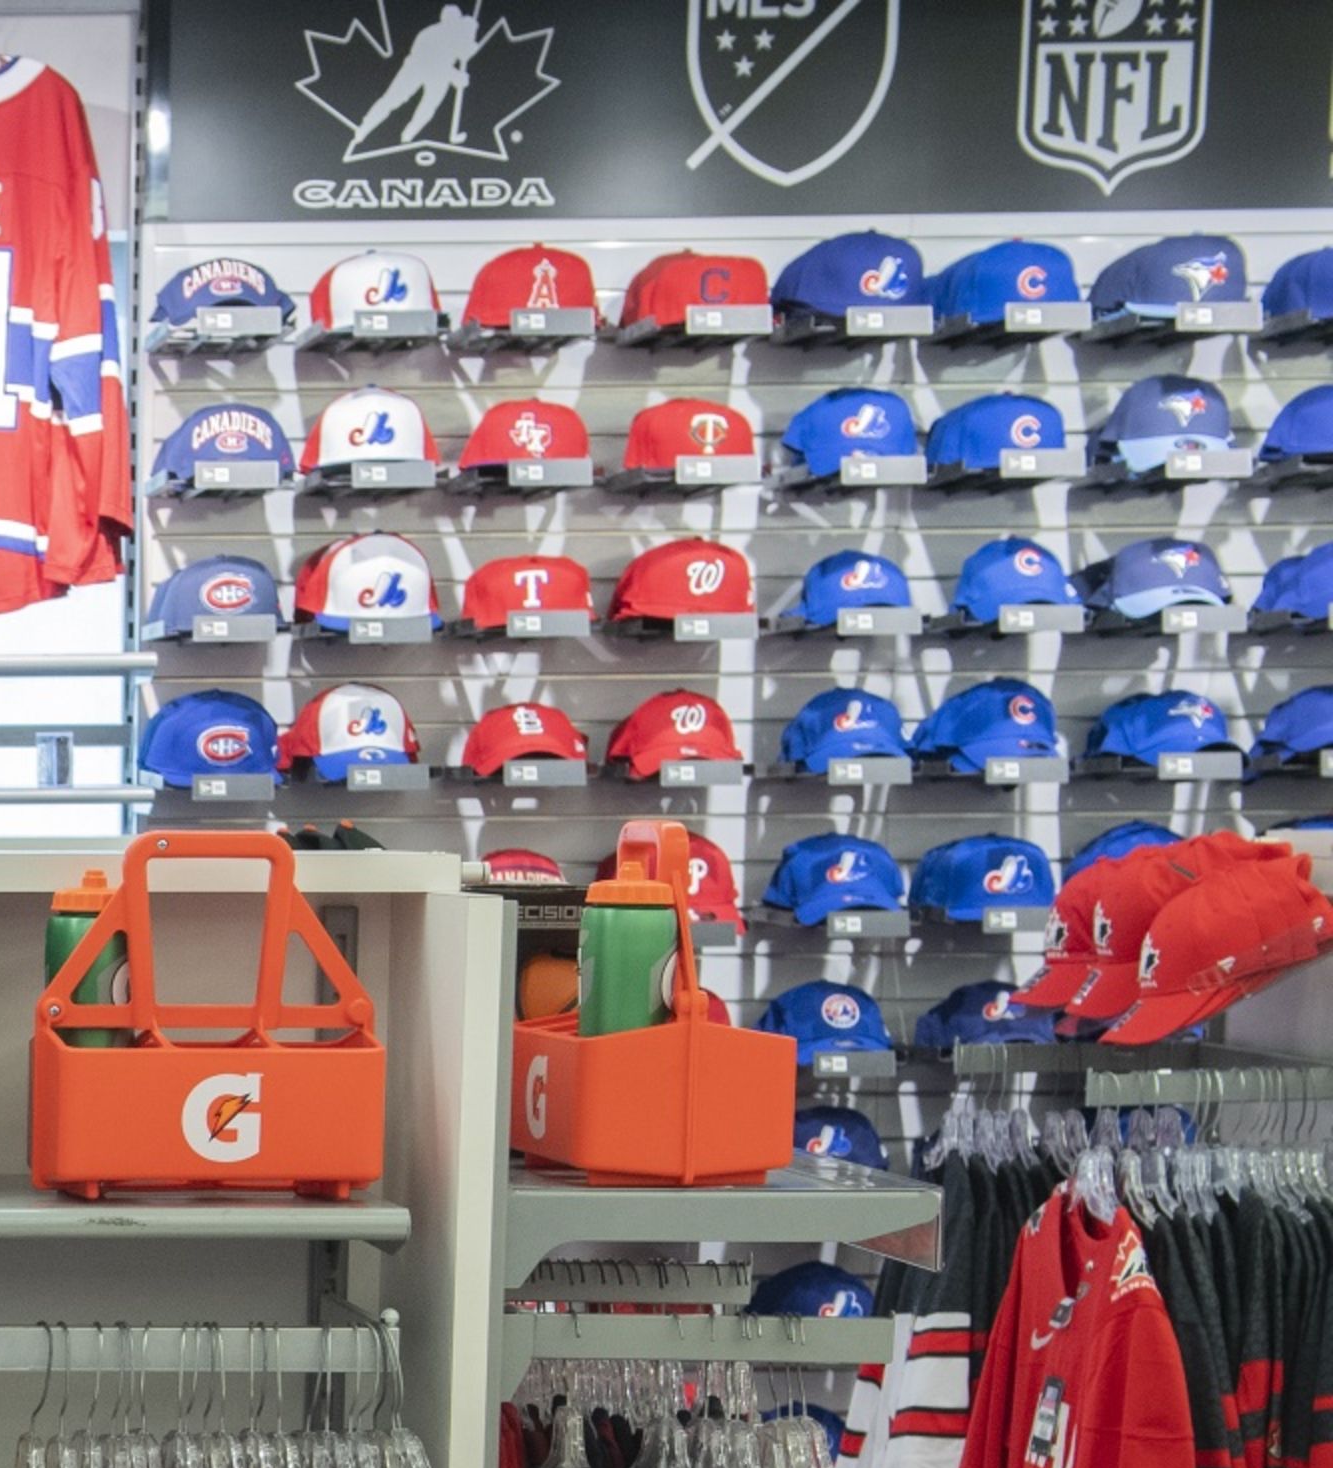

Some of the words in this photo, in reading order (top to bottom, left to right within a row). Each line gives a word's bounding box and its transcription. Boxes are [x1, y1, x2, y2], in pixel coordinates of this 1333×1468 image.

[1042, 51, 1182, 154] NFL
[292, 177, 556, 208] CANADA
[183, 258, 266, 299] CANADIENS
[191, 411, 273, 450] CANADIENS
[181, 1073, 264, 1163] G
